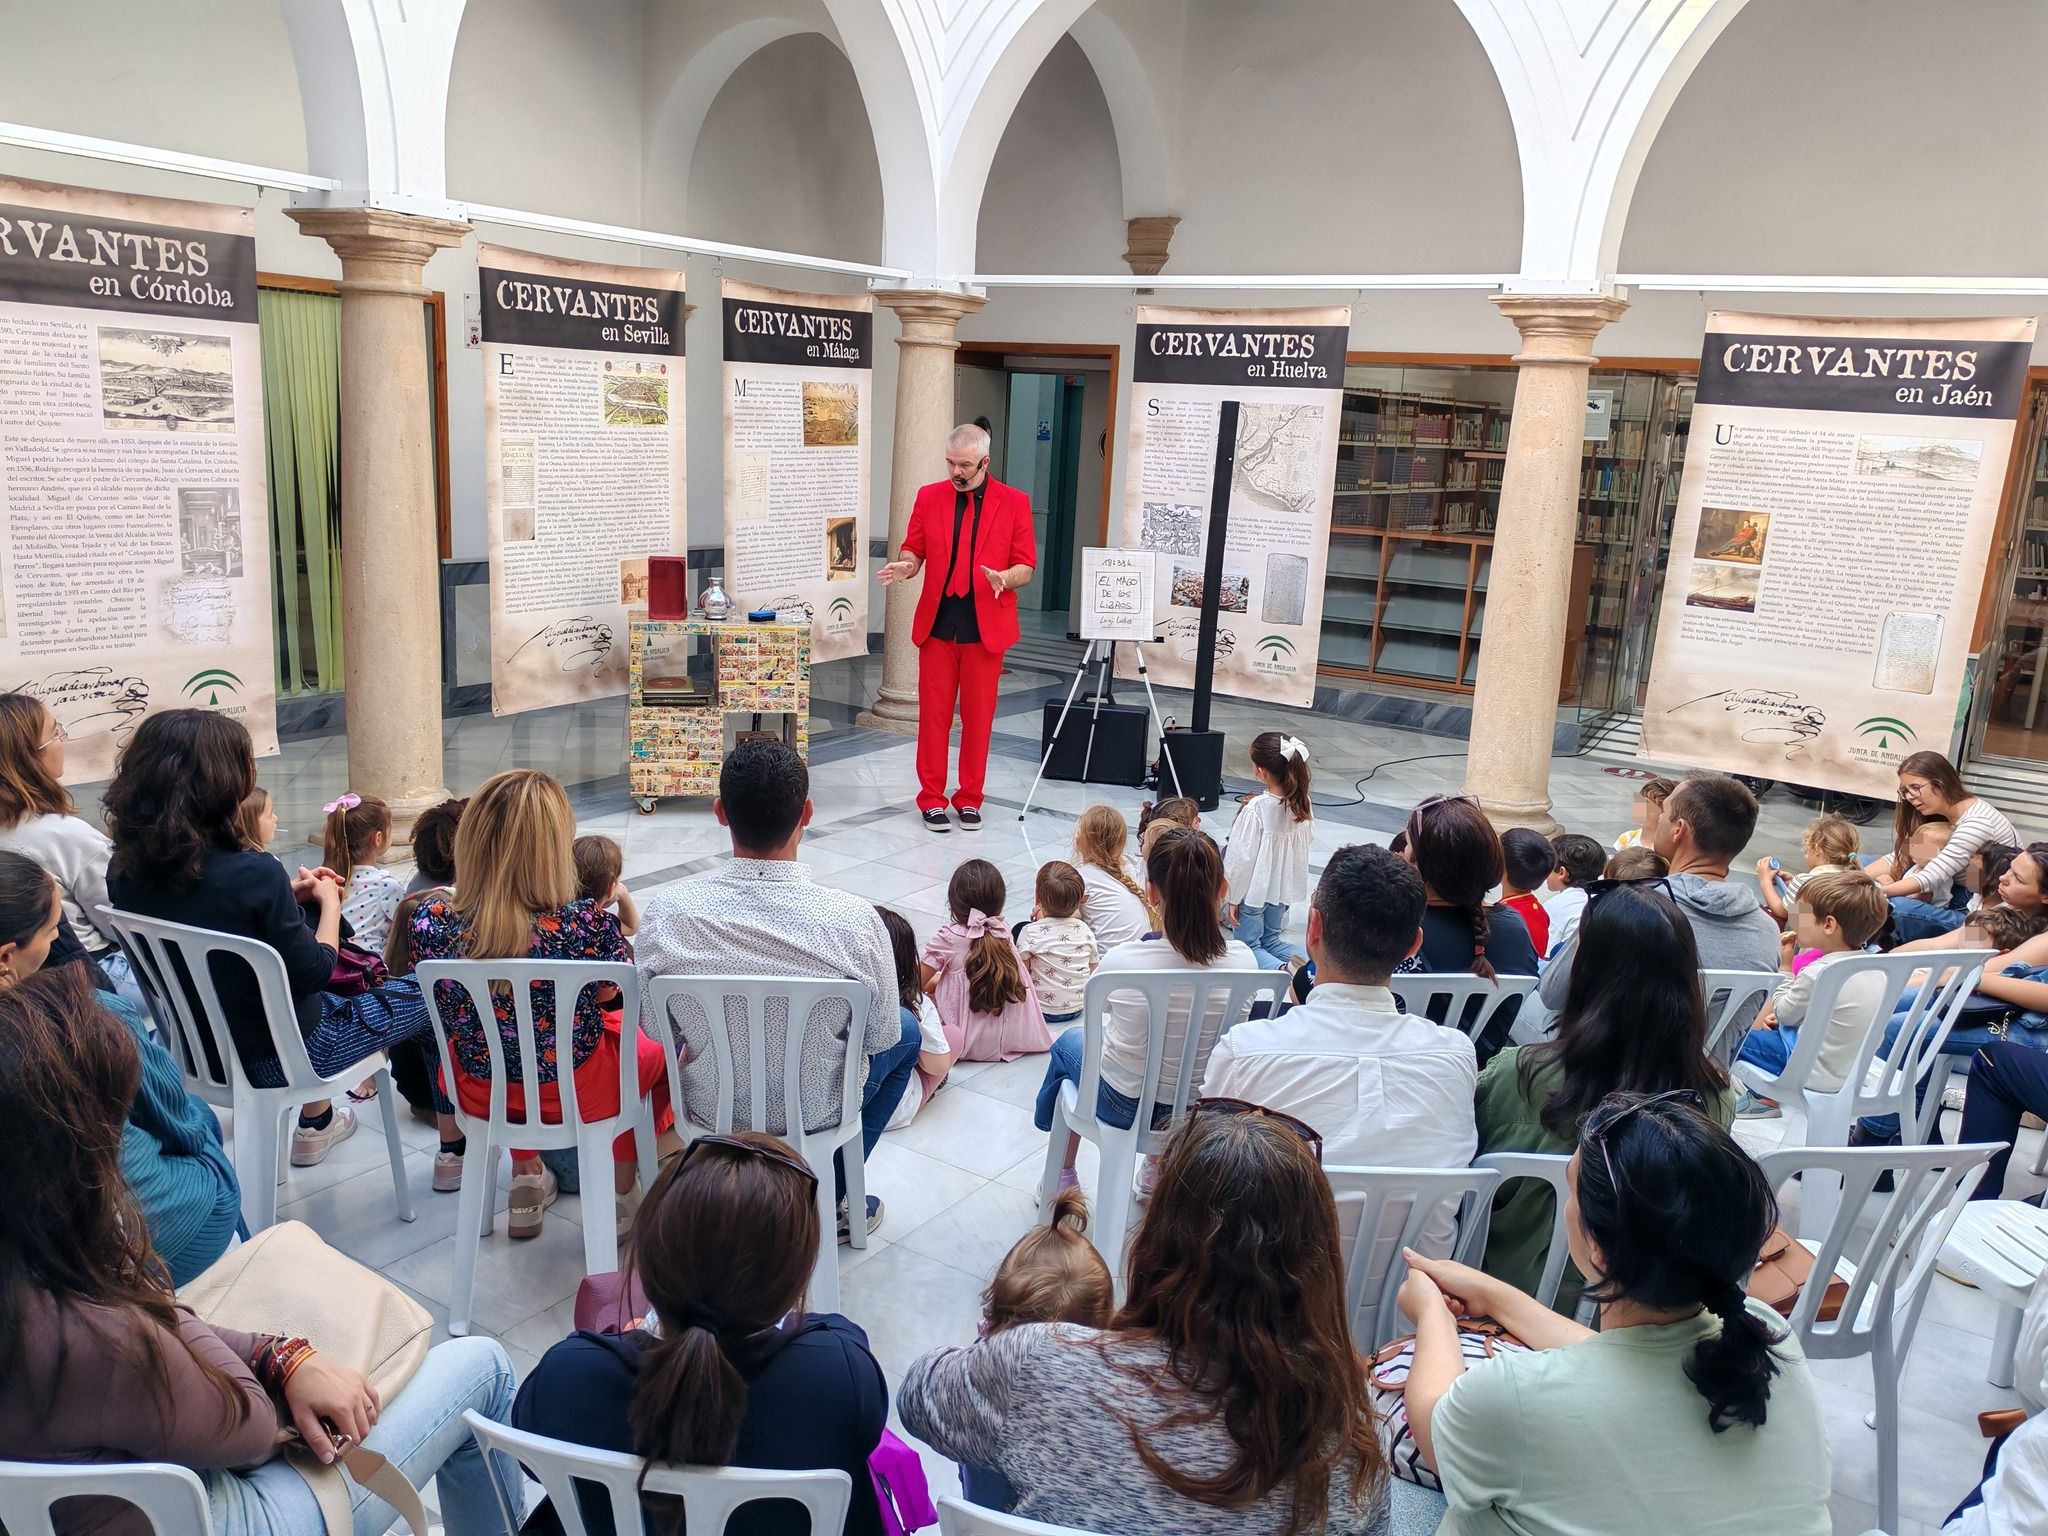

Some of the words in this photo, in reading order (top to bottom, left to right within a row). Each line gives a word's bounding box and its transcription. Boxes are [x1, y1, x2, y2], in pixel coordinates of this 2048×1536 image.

[90, 276, 121, 297] en
[131, 274, 234, 308] Córdoba
[496, 280, 659, 323] CERVANTES
[602, 326, 619, 342] en
[624, 325, 670, 345] Sevilla
[734, 307, 853, 341] CERVANTES
[806, 344, 820, 358] en
[822, 342, 860, 363] Málaga
[1150, 332, 1315, 359] CERVANTES
[1247, 363, 1265, 378] en
[1270, 361, 1328, 379] Huelva
[1723, 343, 1978, 381] CERVANTES
[1895, 387, 1923, 403] en
[1933, 384, 1993, 407] Jaén
[1098, 576, 1111, 586] EL
[1116, 576, 1138, 586] MAGO
[1102, 589, 1112, 598] DE
[1848, 747, 1868, 756] JUNTA
[1871, 750, 1878, 758] DE
